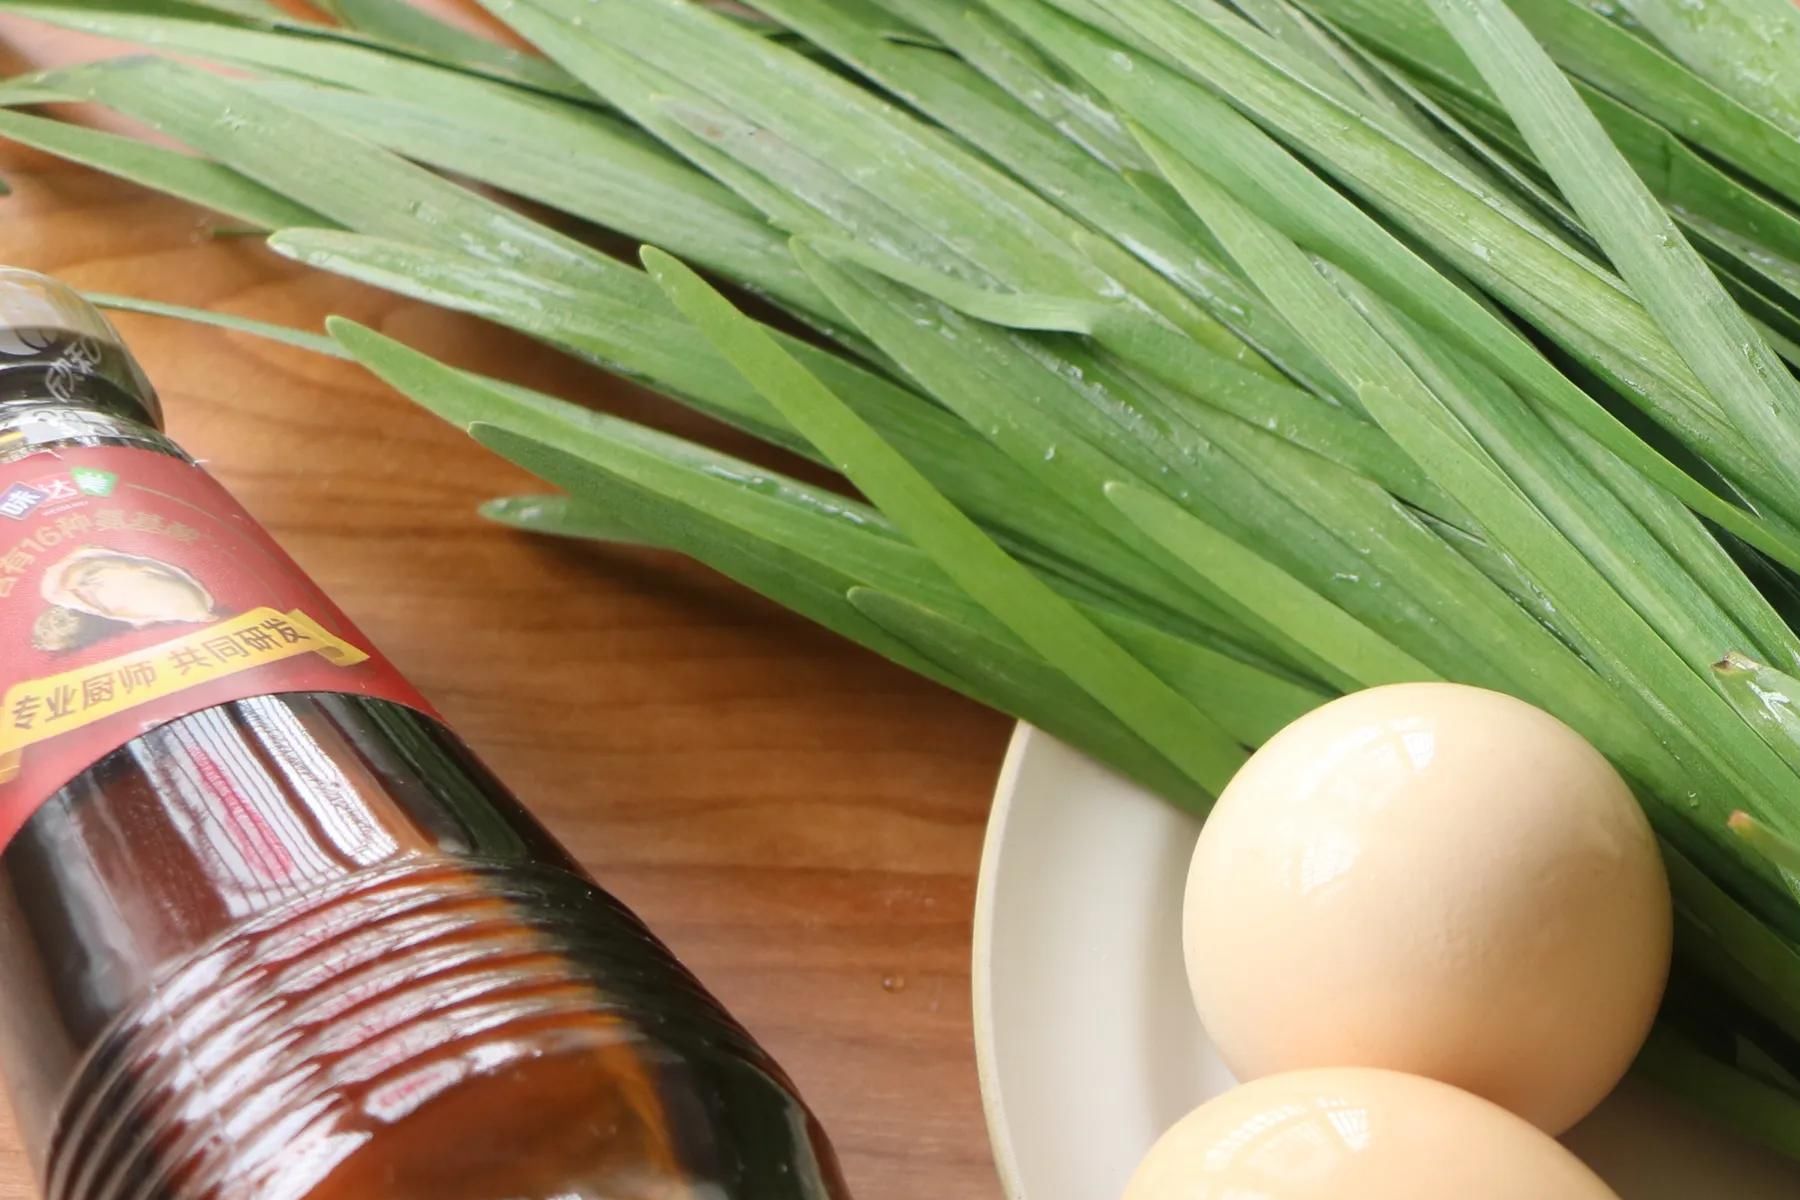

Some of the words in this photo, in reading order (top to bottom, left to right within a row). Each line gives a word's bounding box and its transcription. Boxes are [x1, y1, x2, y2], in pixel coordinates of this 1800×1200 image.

[12, 659, 157, 731] 专业厨师
[170, 617, 310, 676] 共同研发
